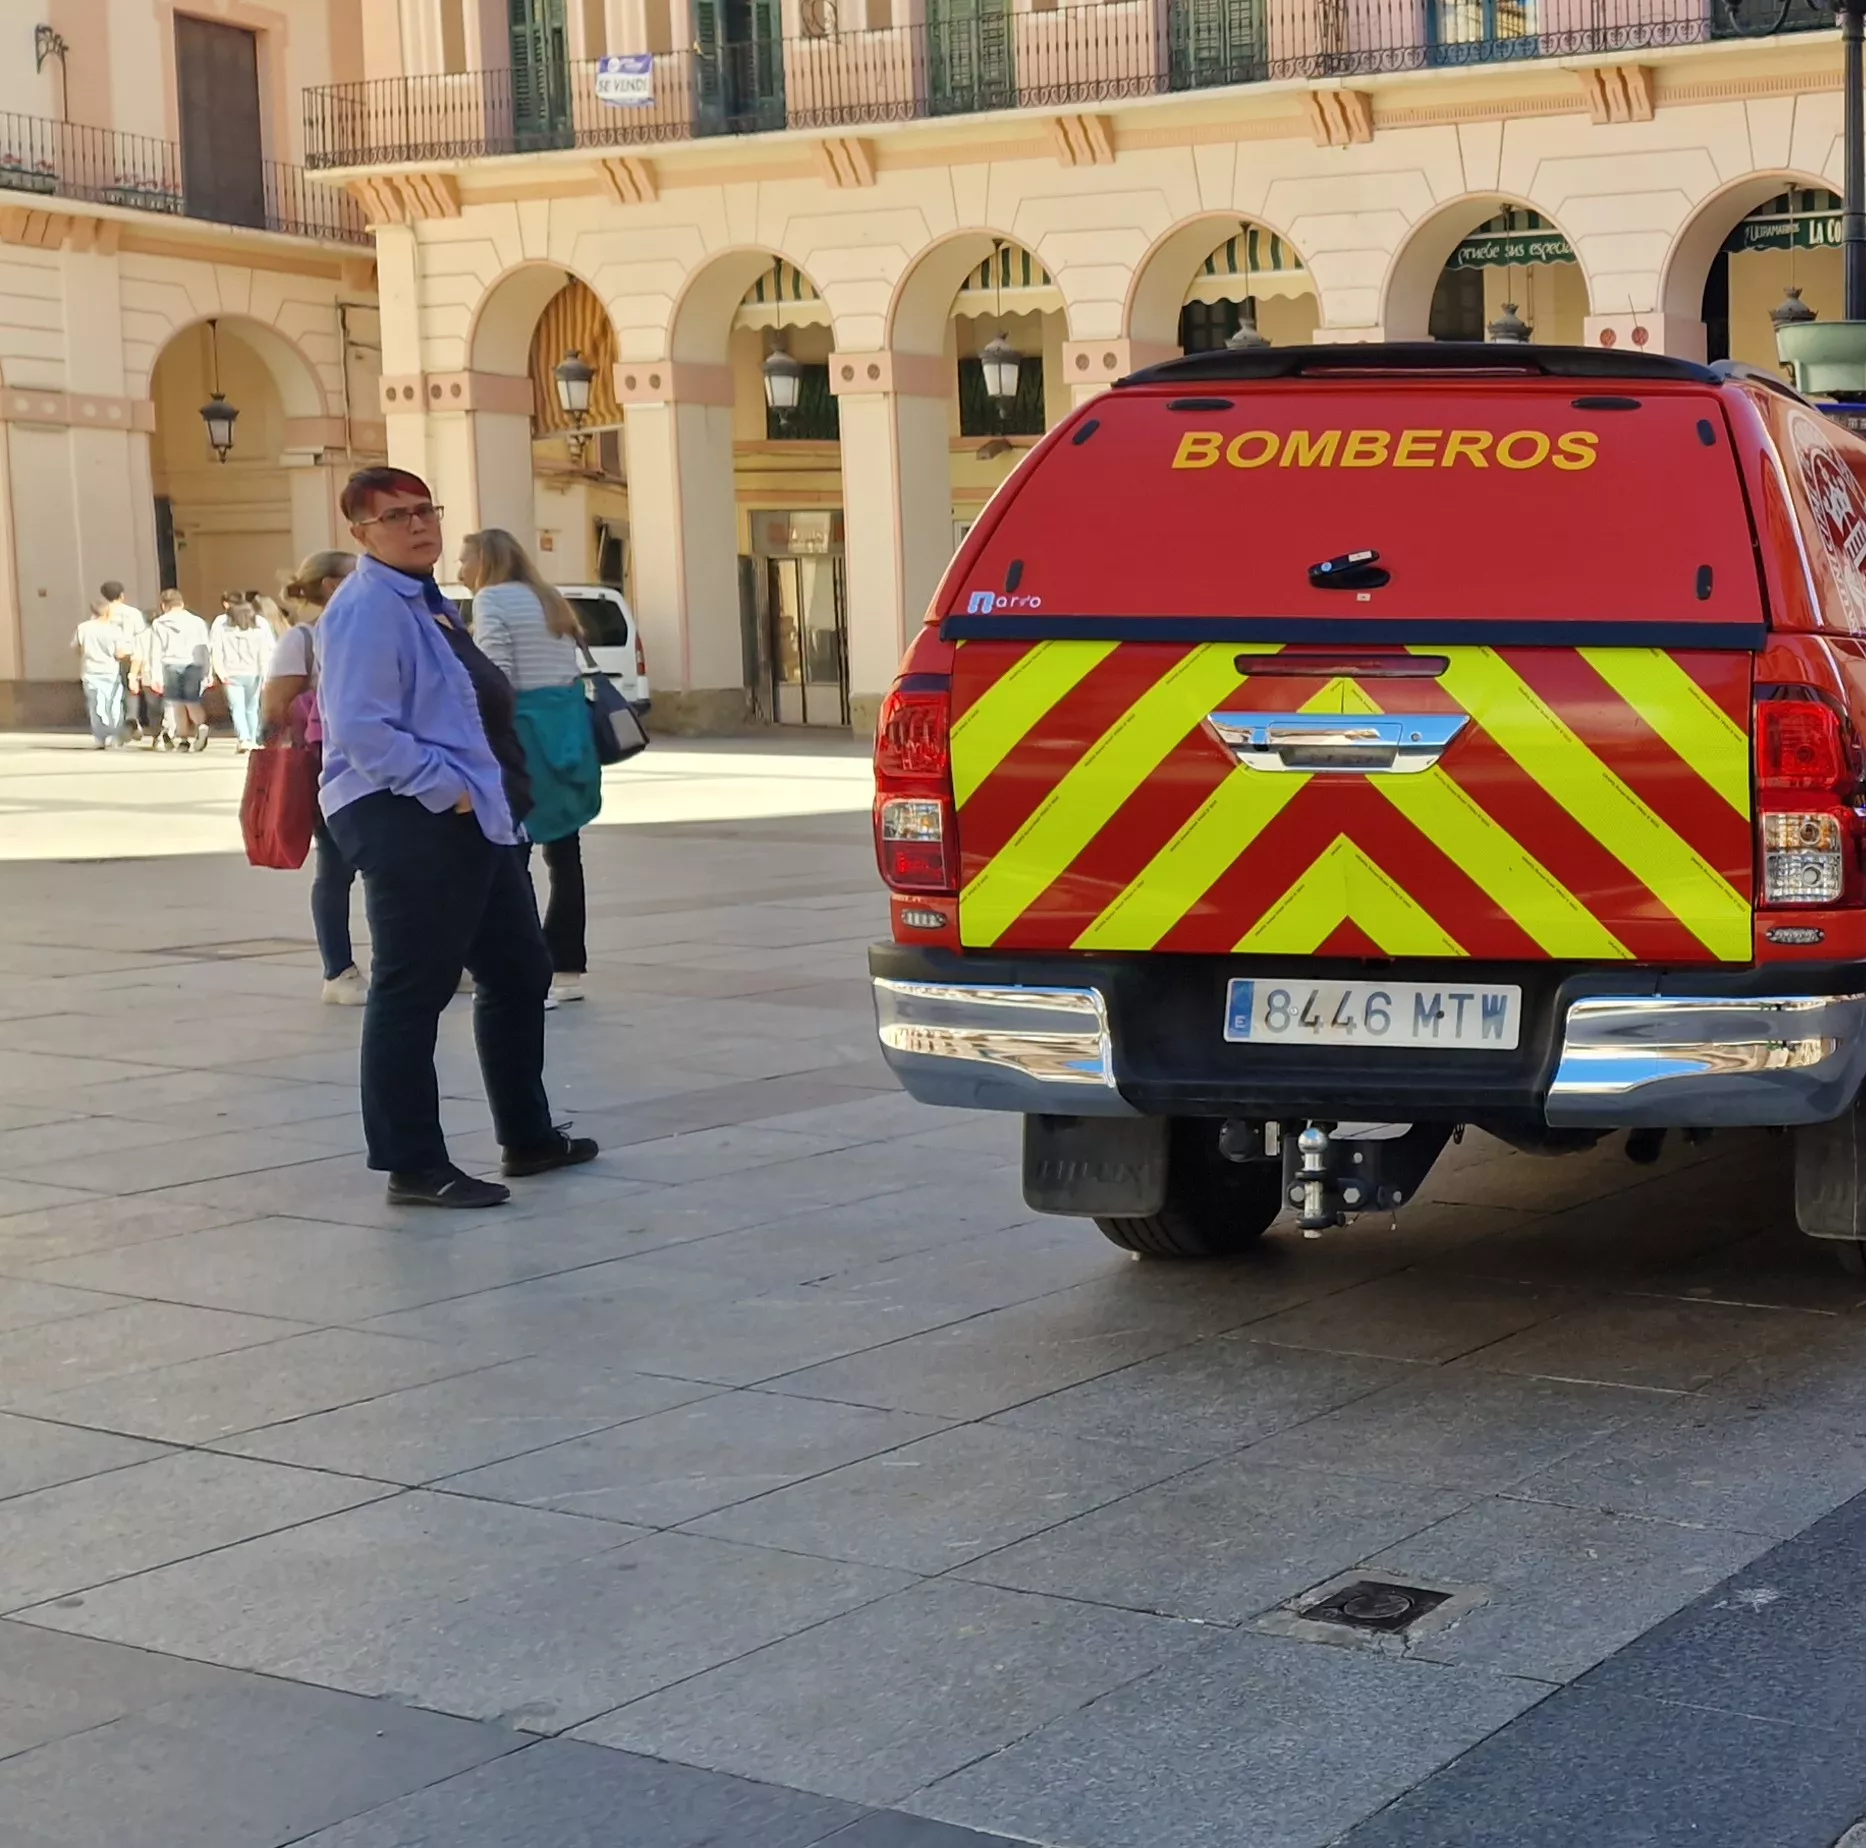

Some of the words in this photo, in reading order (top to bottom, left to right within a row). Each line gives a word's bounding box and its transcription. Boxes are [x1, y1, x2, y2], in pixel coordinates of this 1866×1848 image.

[1809, 219, 1824, 244] LA
[1827, 218, 1845, 243] CO
[1171, 429, 1600, 471] BOMBEROS
[1234, 1015, 1245, 1028] E
[1264, 989, 1391, 1035] 8446
[1412, 992, 1508, 1040] MTW
